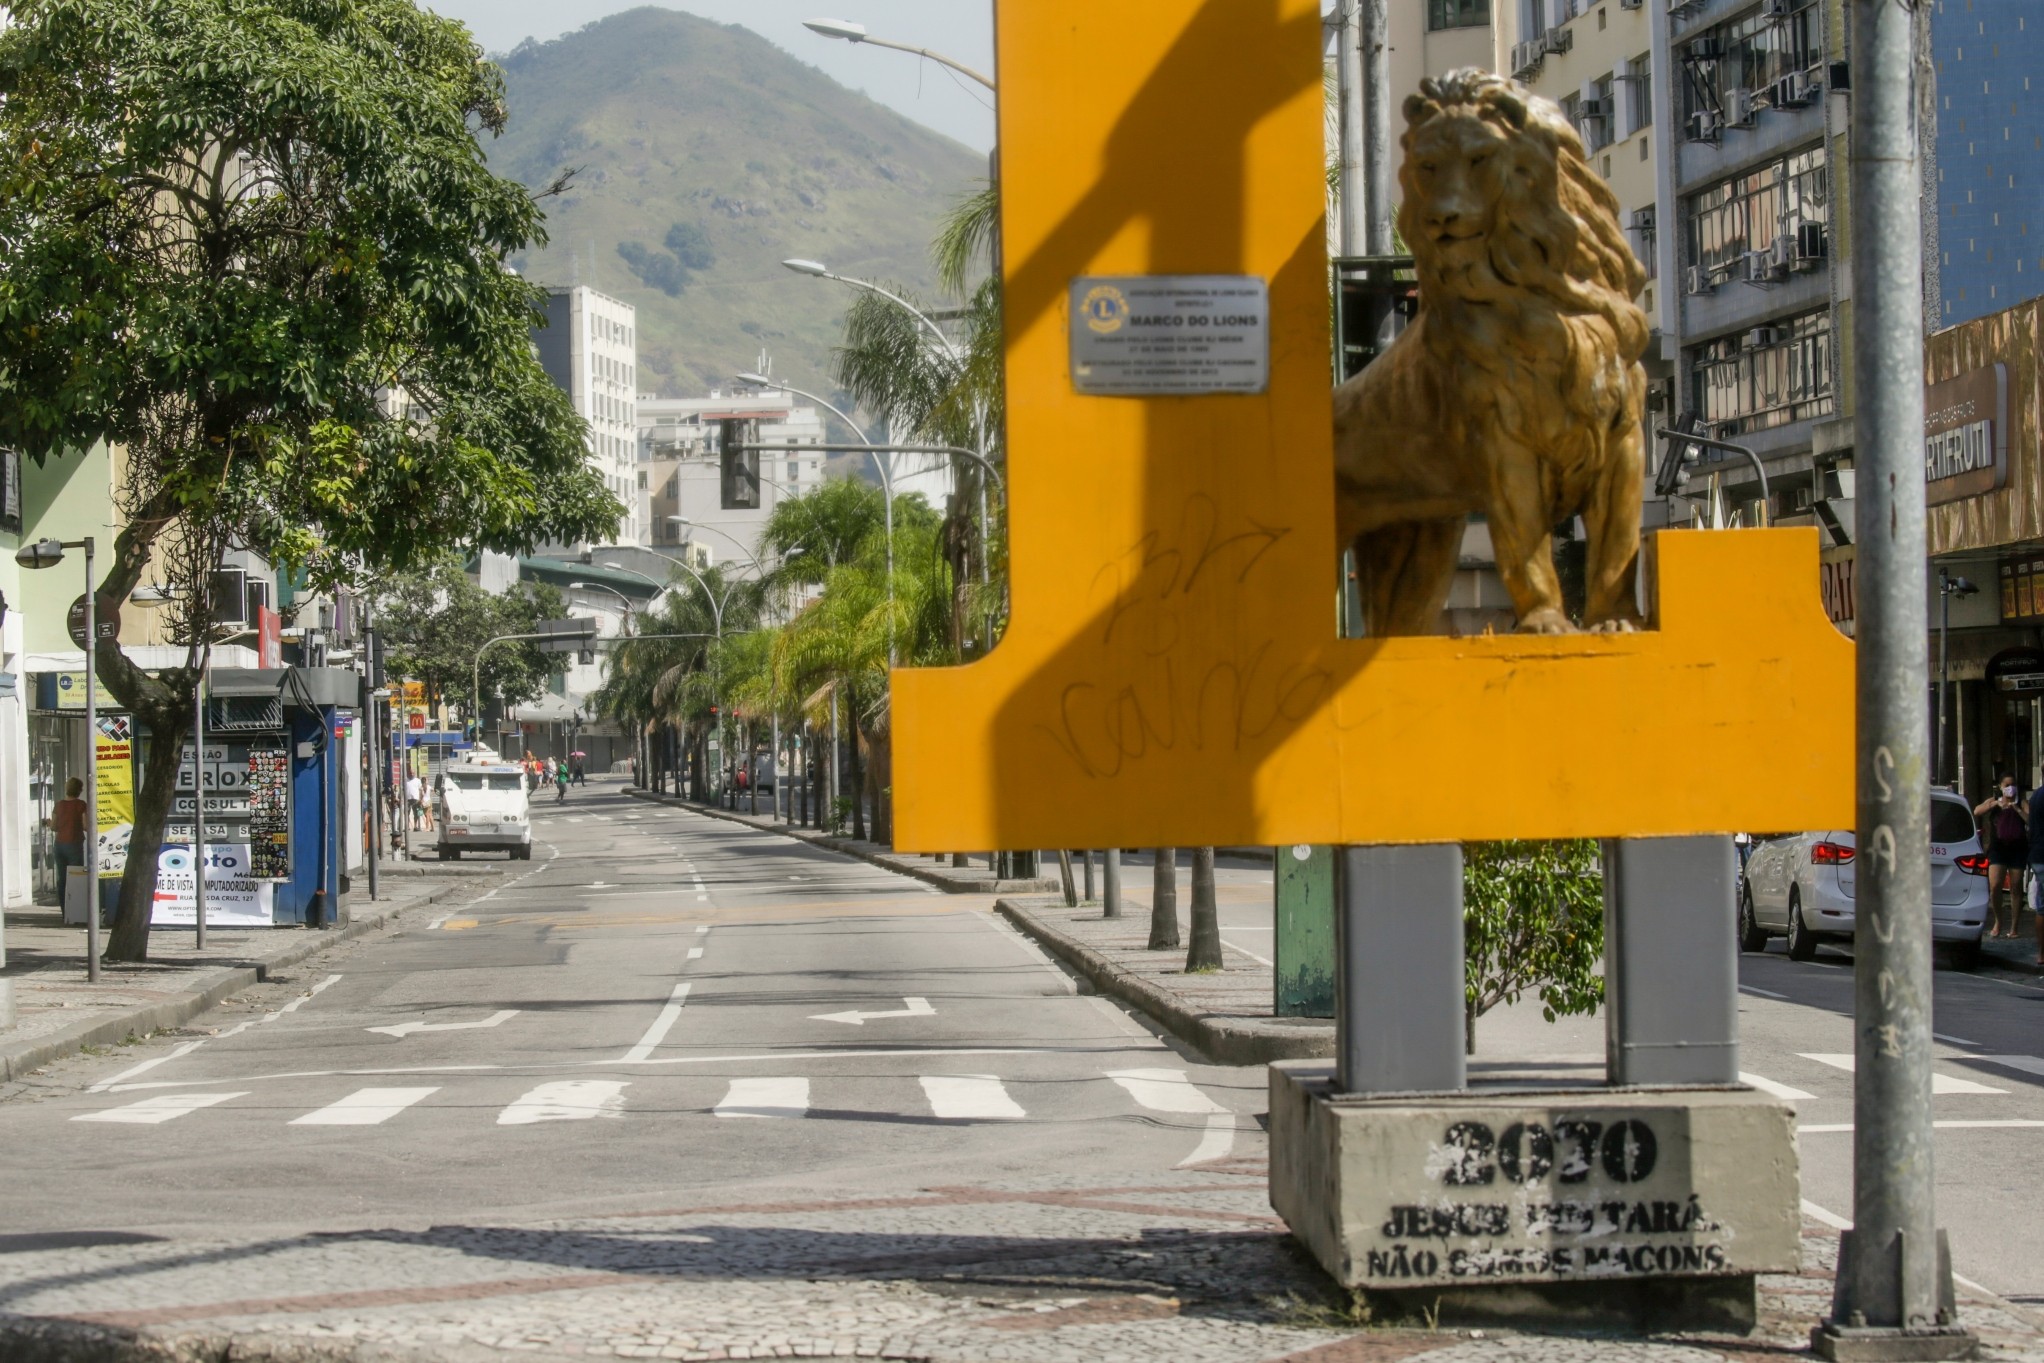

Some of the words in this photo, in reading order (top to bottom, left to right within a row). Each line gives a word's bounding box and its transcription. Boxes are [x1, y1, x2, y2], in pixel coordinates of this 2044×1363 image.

[1130, 314, 1183, 326] MARCO
[1188, 314, 1208, 326] DO
[1213, 314, 1258, 326] LIONS
[1925, 419, 1991, 482] RTIFRUTI
[183, 751, 222, 760] ESSÃO
[180, 771, 250, 787] EROX
[178, 800, 248, 809] CONSULT
[167, 880, 176, 891] DE
[176, 880, 194, 891] VISTA
[204, 880, 259, 892] MPUTADORIZADO
[1382, 1204, 1510, 1238] JESUS
[1367, 1244, 1438, 1278] NÃO
